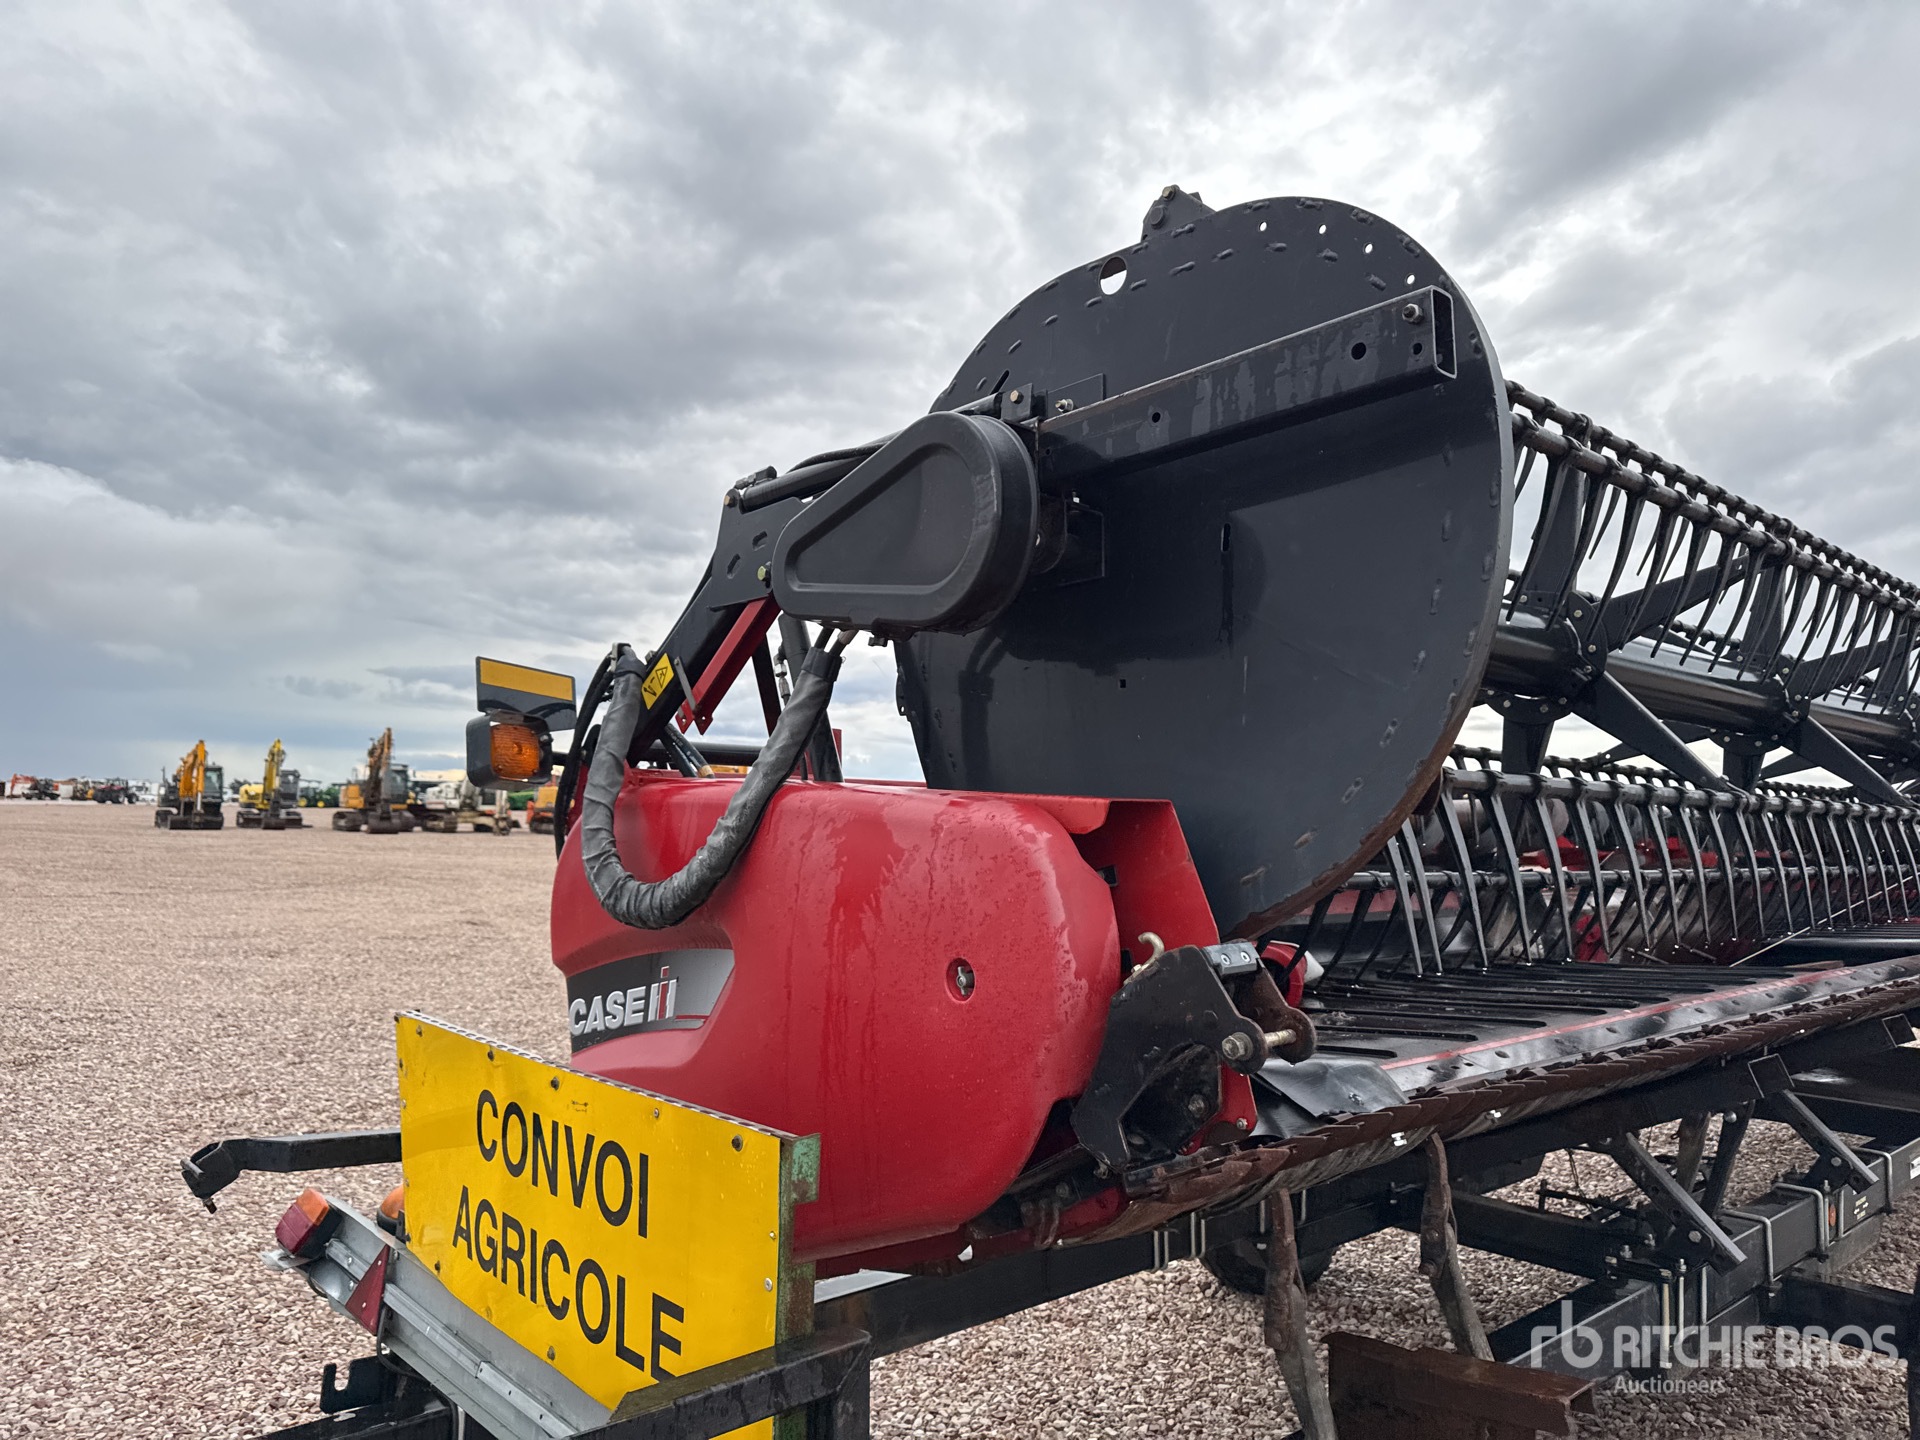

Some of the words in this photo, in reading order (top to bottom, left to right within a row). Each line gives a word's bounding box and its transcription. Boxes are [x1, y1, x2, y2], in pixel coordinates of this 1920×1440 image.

[569, 986, 646, 1036] CASE
[476, 1089, 649, 1239] CONVOI
[452, 1185, 685, 1381] AGRICOLE
